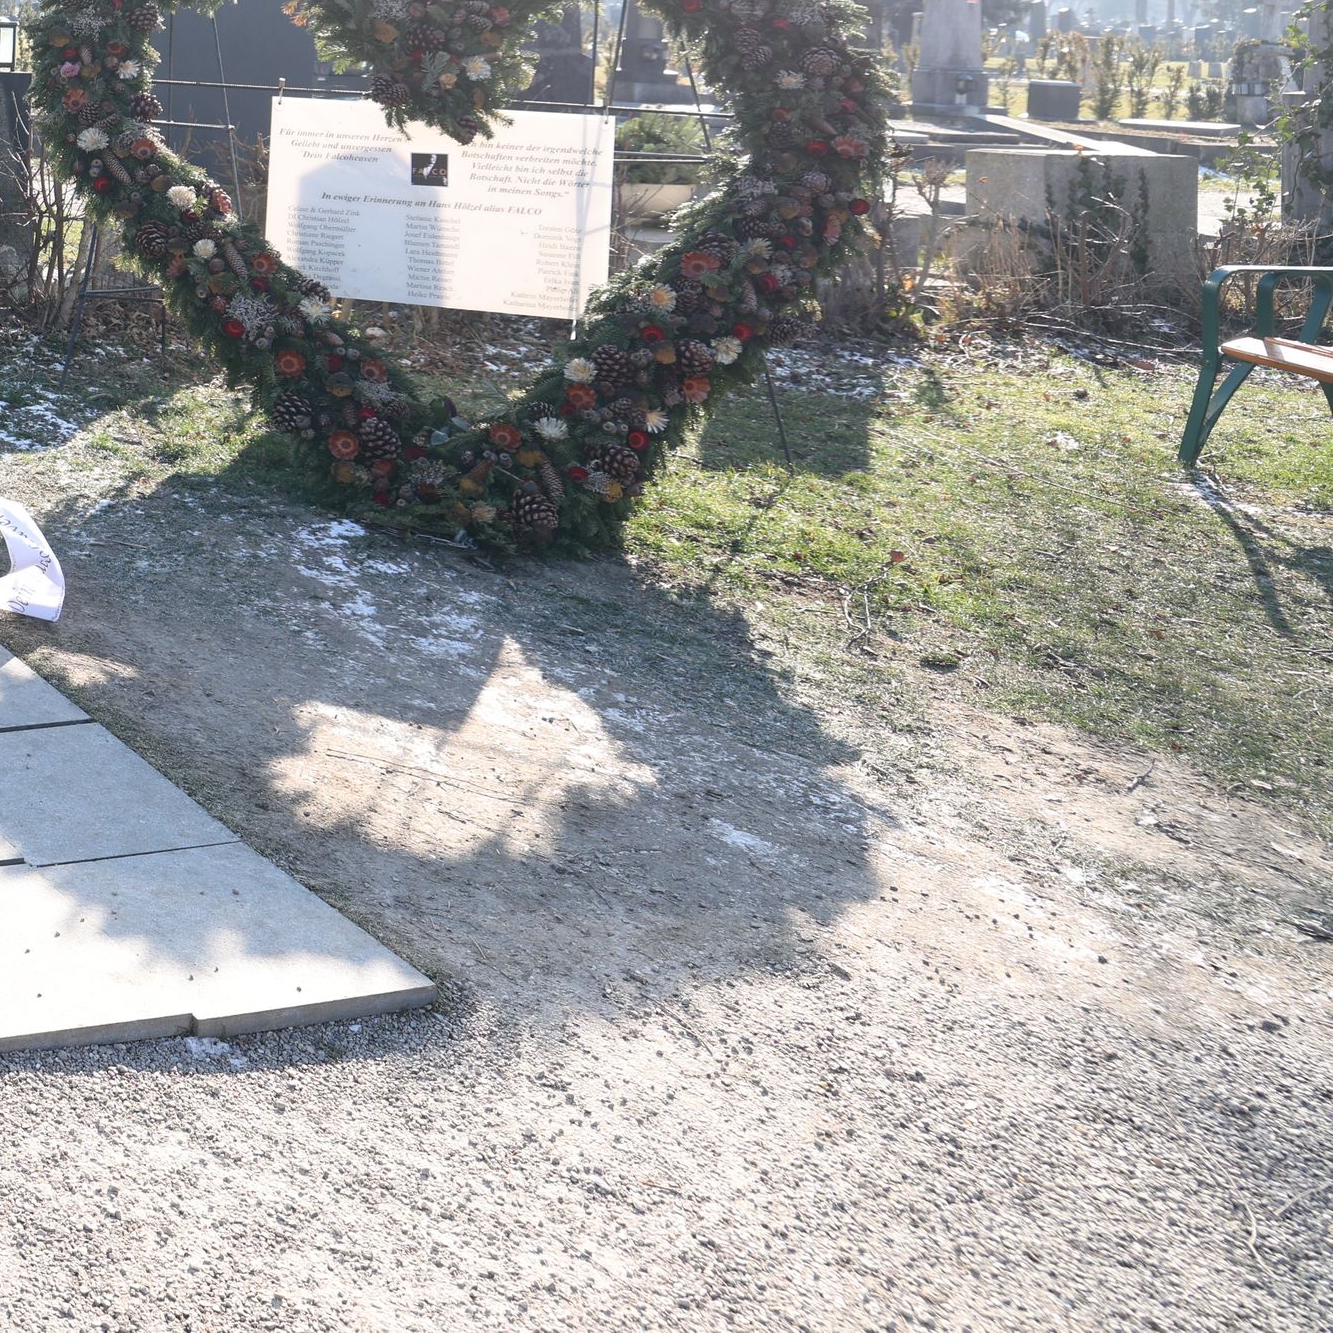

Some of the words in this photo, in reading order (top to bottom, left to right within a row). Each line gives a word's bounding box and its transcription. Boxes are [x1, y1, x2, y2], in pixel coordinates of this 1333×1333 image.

[279, 128, 295, 137] Für
[297, 129, 324, 137] immer
[336, 133, 370, 141] unseren
[372, 134, 403, 144] Herzen
[291, 139, 320, 148] Geliebt
[321, 142, 339, 150] und
[340, 144, 393, 153] unvergessen
[496, 142, 523, 150] keiner
[526, 144, 541, 152] der
[543, 145, 603, 156] irgendwelche
[303, 151, 323, 159] Dein
[325, 152, 379, 163] Falcoheaven
[461, 151, 513, 161] Botschaften
[515, 155, 560, 164] verbreiten
[412, 167, 447, 176] FACO
[472, 162, 513, 172] Vielleicht
[515, 165, 529, 173] bin
[531, 166, 545, 174] ich
[548, 168, 574, 176] selbst
[575, 169, 589, 177] die
[516, 176, 541, 184] Nicht
[542, 178, 556, 186] die
[487, 185, 498, 193] in
[500, 187, 532, 195] meinen
[333, 194, 361, 203] ewiger
[363, 195, 413, 207] Erinnerung
[428, 200, 451, 209] Hans
[484, 204, 505, 213] alias
[507, 206, 542, 216] FALCO
